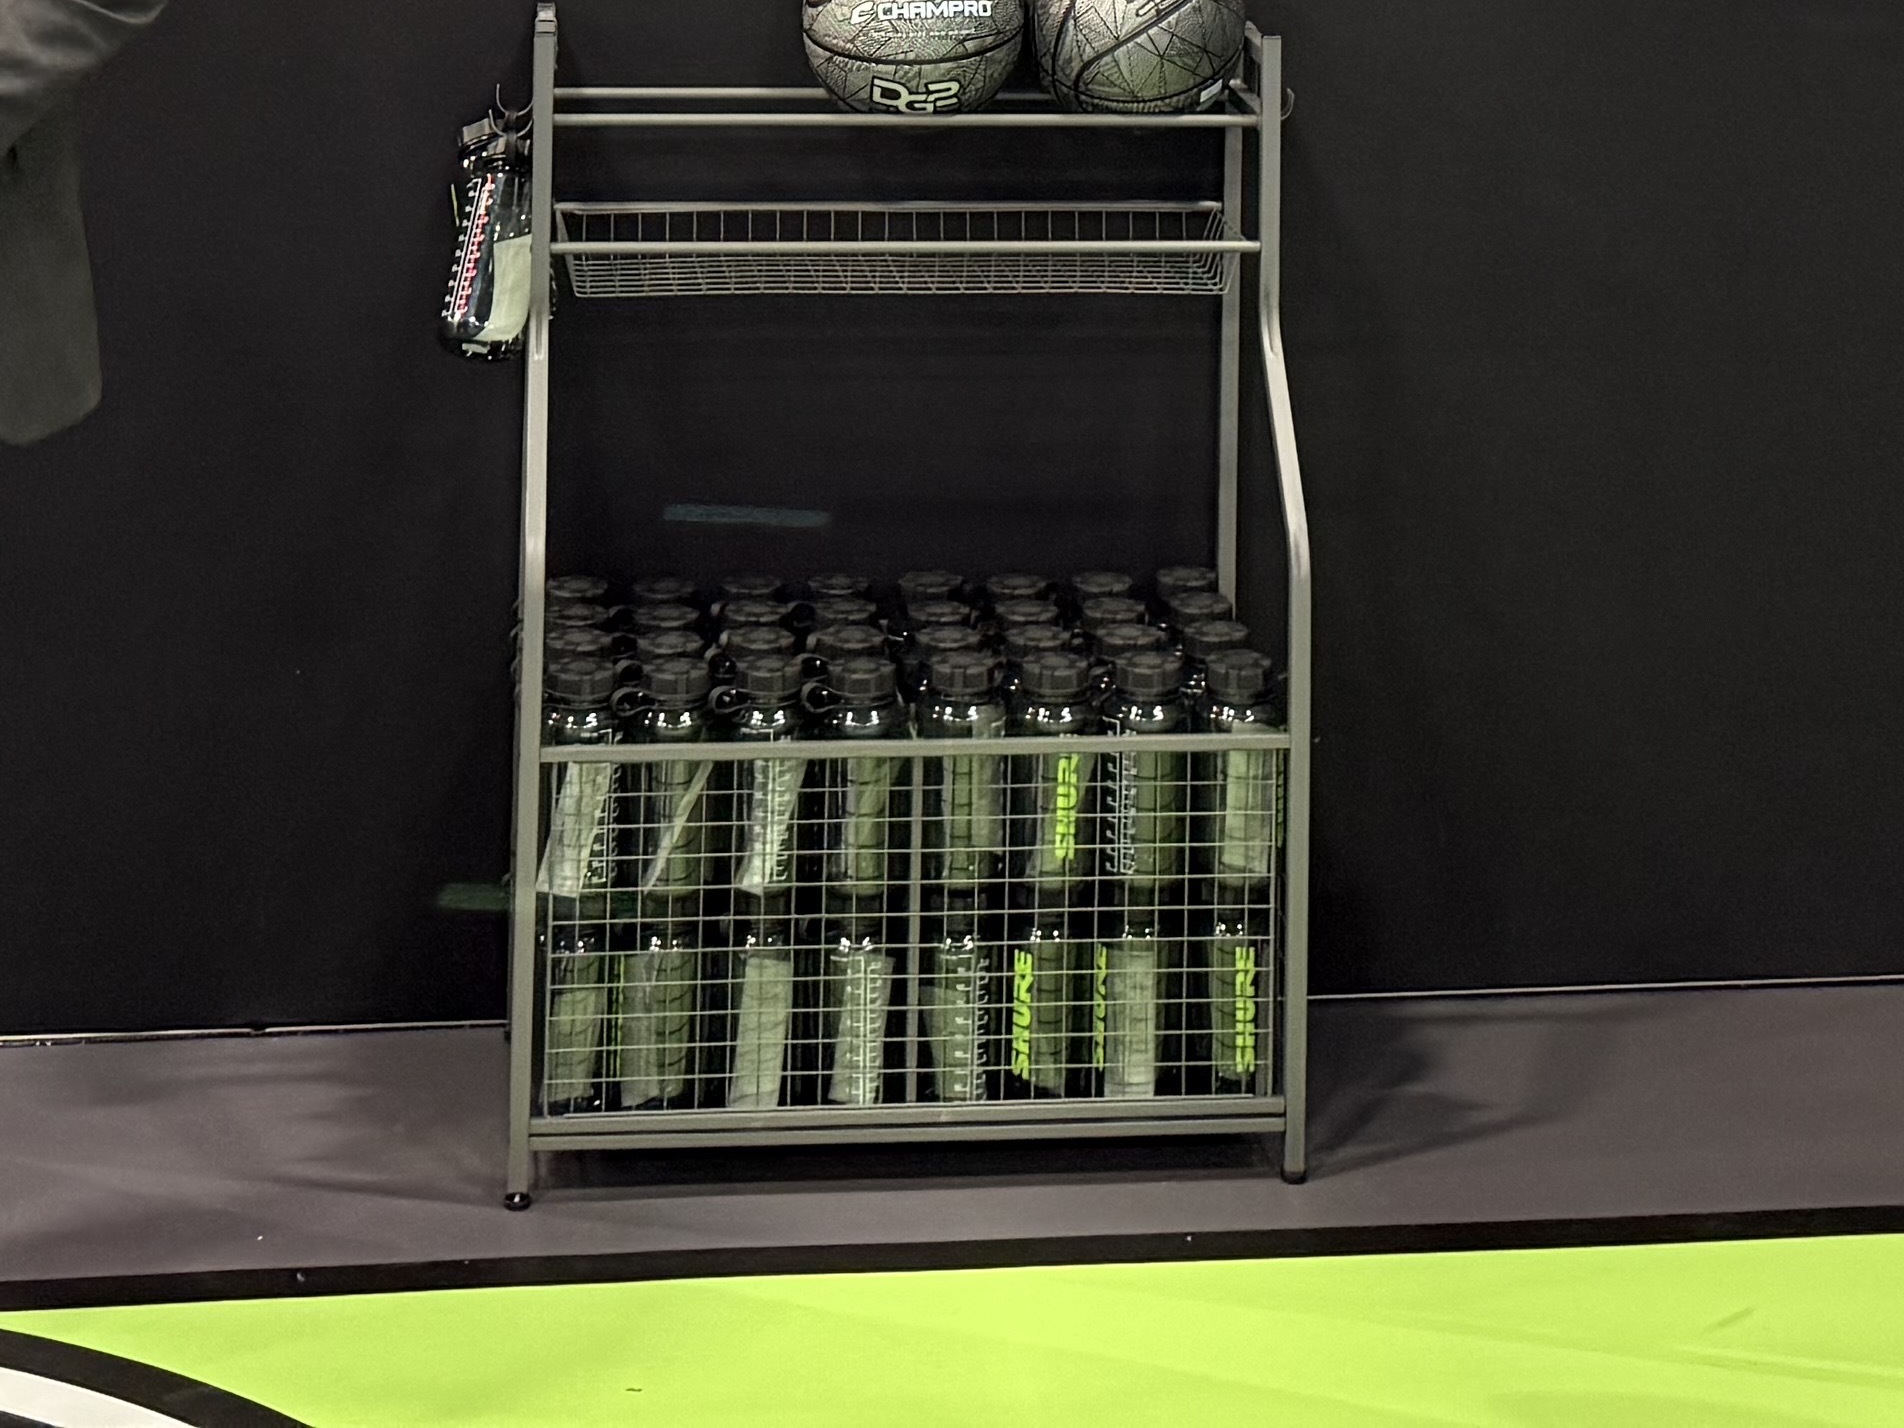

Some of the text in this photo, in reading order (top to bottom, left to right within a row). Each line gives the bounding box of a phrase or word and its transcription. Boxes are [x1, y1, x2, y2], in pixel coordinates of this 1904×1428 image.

[877, 0, 994, 21] CHAMPRO
[1055, 752, 1079, 861] SHUR
[1011, 948, 1034, 1081] SHURE
[1234, 945, 1256, 1074] SHURE
